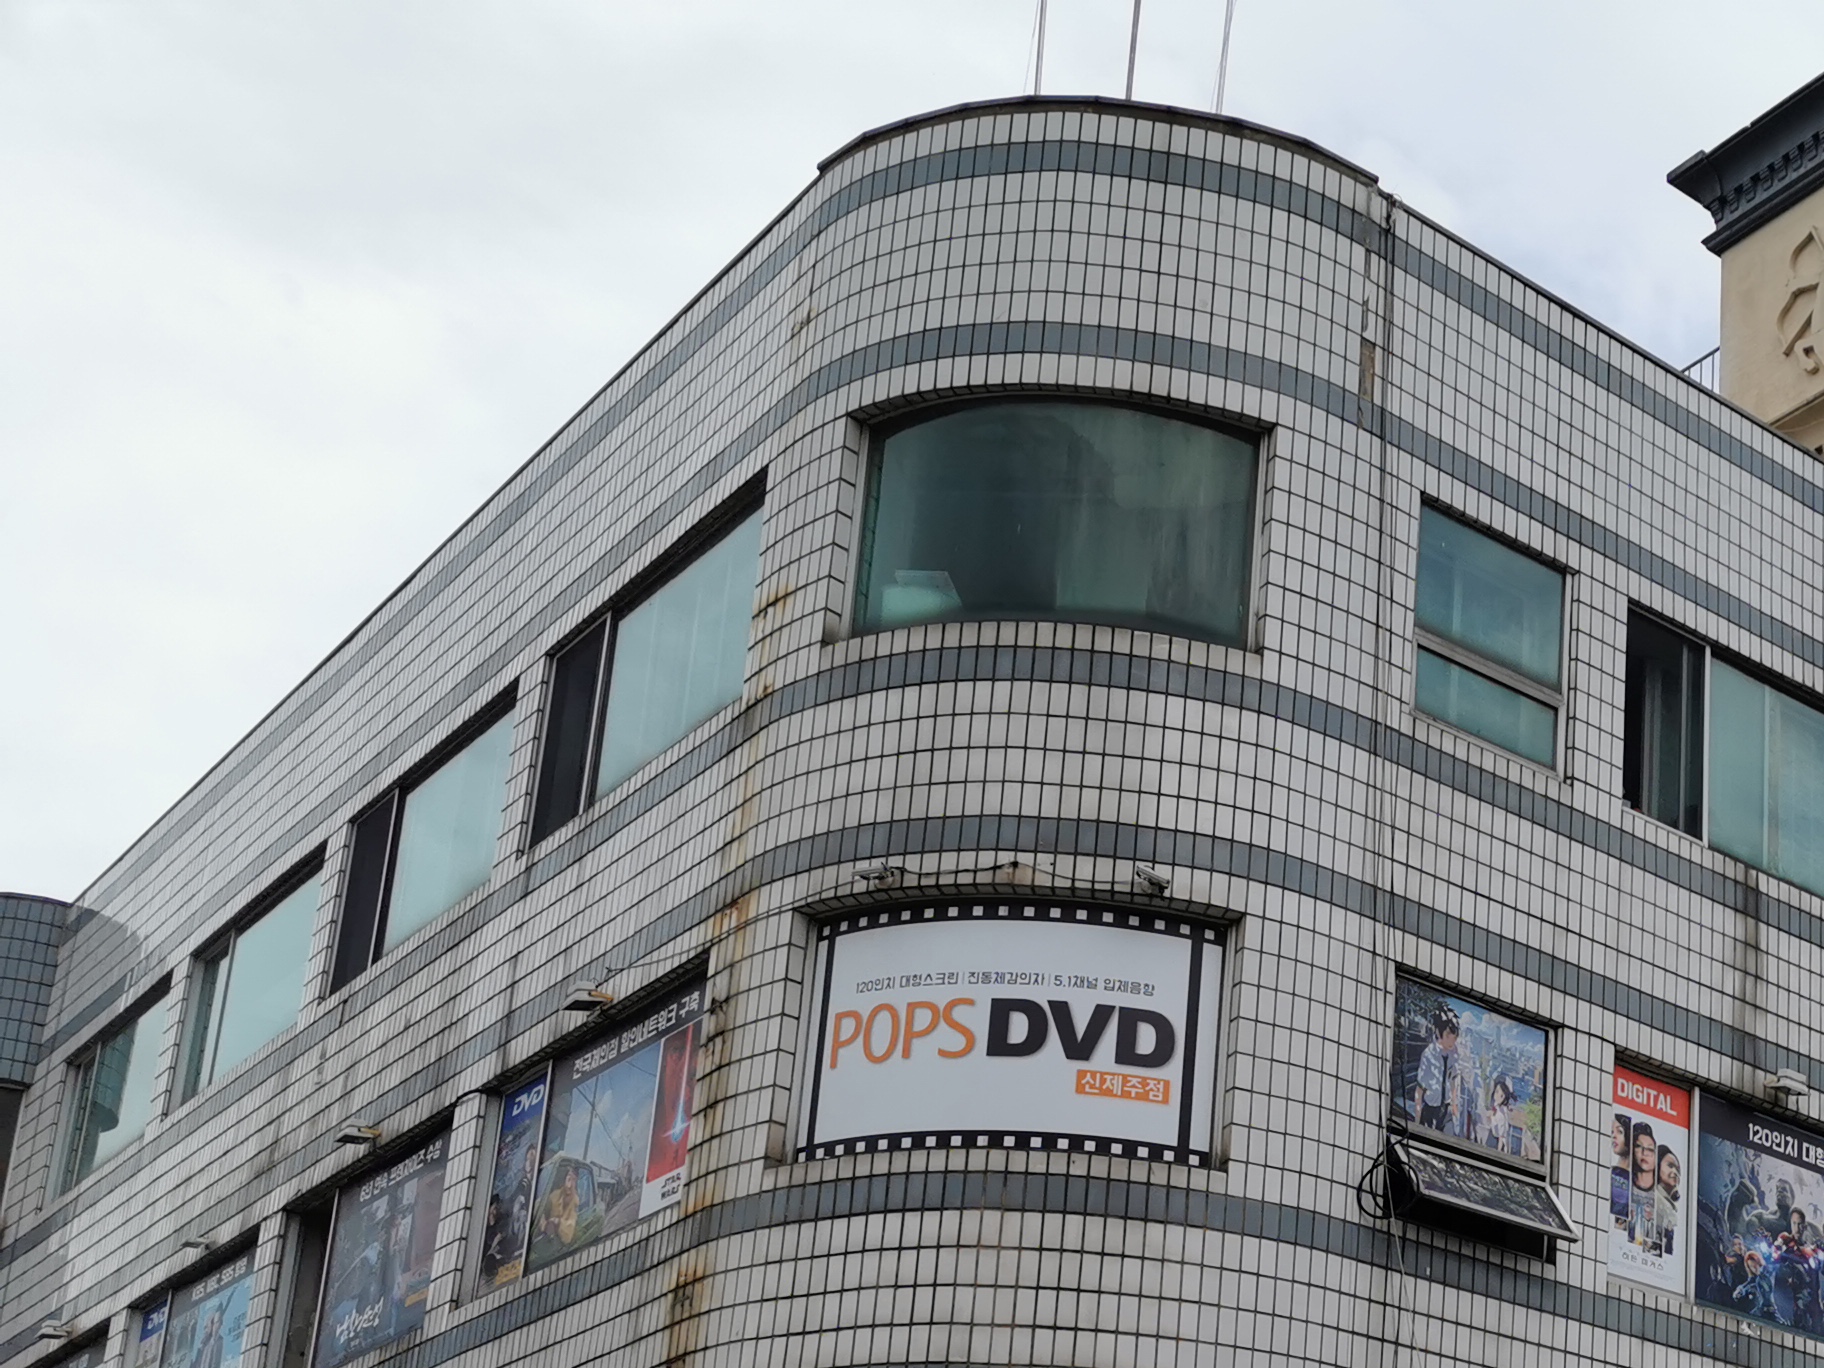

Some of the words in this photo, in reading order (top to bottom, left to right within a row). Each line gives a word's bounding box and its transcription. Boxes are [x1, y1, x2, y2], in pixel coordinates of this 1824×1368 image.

[855, 974, 896, 995] 120인치
[899, 970, 960, 990] 대형스크린
[967, 969, 1046, 987] 진동체감의자
[1053, 973, 1099, 991] 5.1채널
[1103, 977, 1156, 998] 입체음향
[679, 990, 701, 1018] 구축
[829, 997, 977, 1070] POPS
[985, 997, 1177, 1069] DVD
[511, 1083, 545, 1117] DVD
[1079, 1071, 1167, 1103] 신제주점
[1616, 1077, 1679, 1117] DIGITAL
[1747, 1122, 1799, 1159] 120인치
[660, 1184, 681, 1201] WARS
